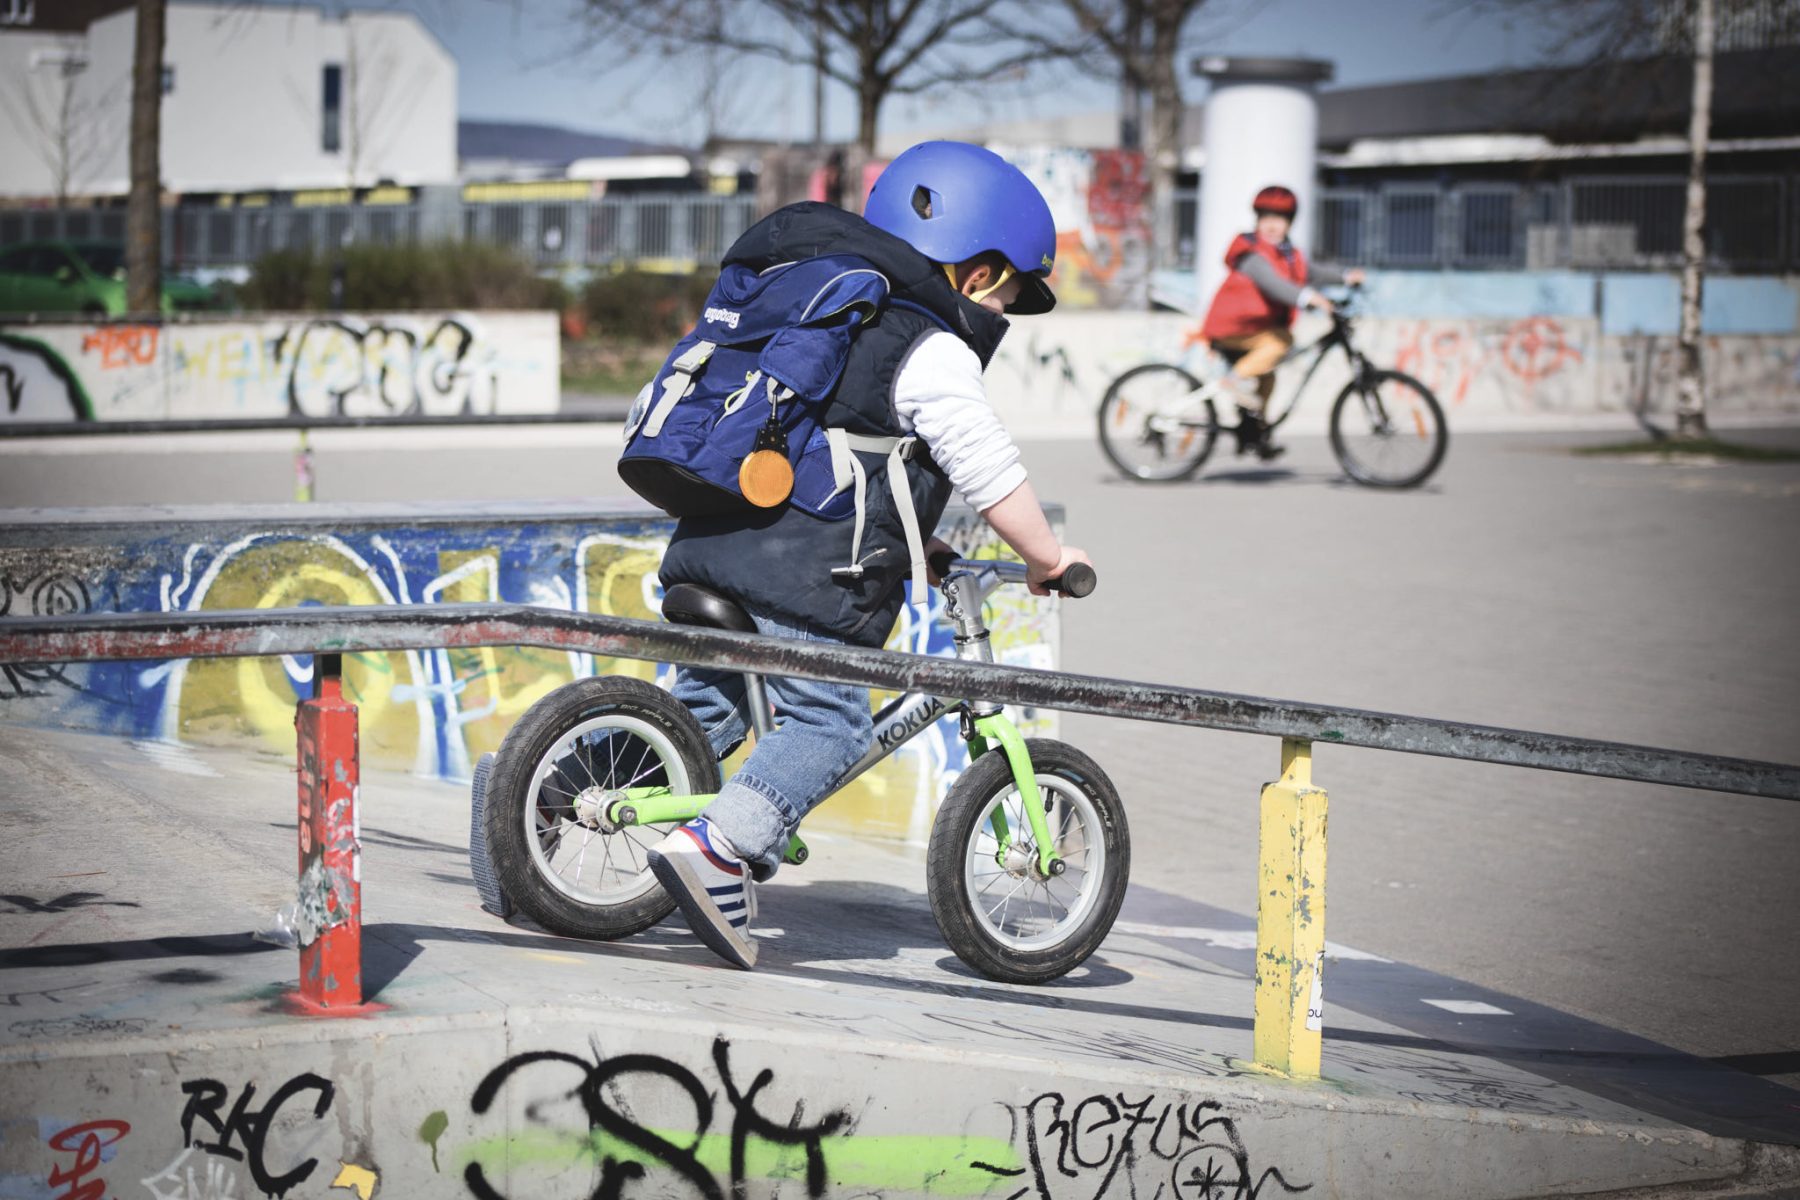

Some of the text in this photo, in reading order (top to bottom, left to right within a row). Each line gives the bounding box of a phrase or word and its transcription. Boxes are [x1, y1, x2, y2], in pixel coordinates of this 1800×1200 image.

[619, 703, 639, 711] BIG
[640, 708, 673, 728] APPLE
[877, 697, 945, 752] KOKUA
[1083, 783, 1112, 828] BIG APPLE
